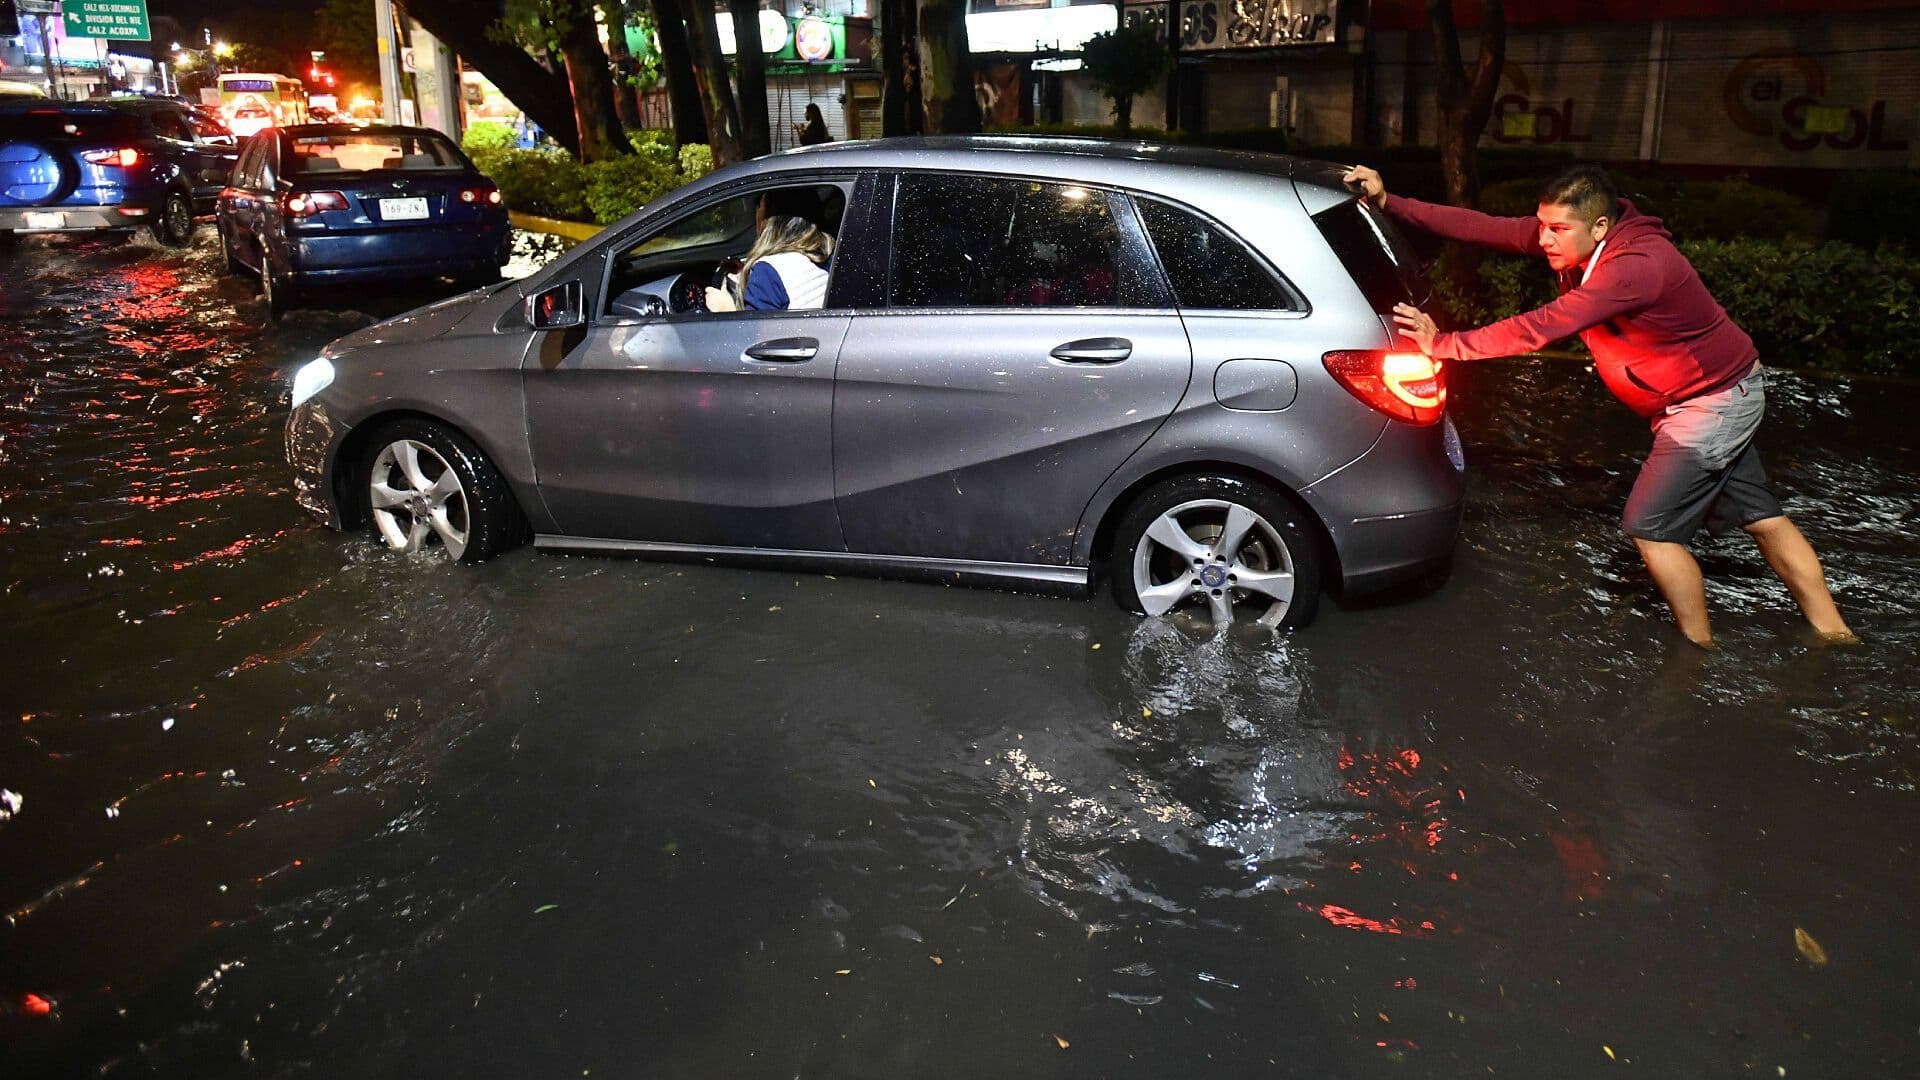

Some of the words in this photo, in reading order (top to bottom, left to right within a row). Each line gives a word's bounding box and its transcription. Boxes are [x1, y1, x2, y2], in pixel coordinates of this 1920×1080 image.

[84, 3, 97, 11] CALZ
[85, 15, 114, 23] DIVISION
[115, 16, 128, 24] DEL
[129, 16, 142, 25] NTE
[87, 26, 107, 34] CALZ
[109, 27, 139, 35] ACOXPA
